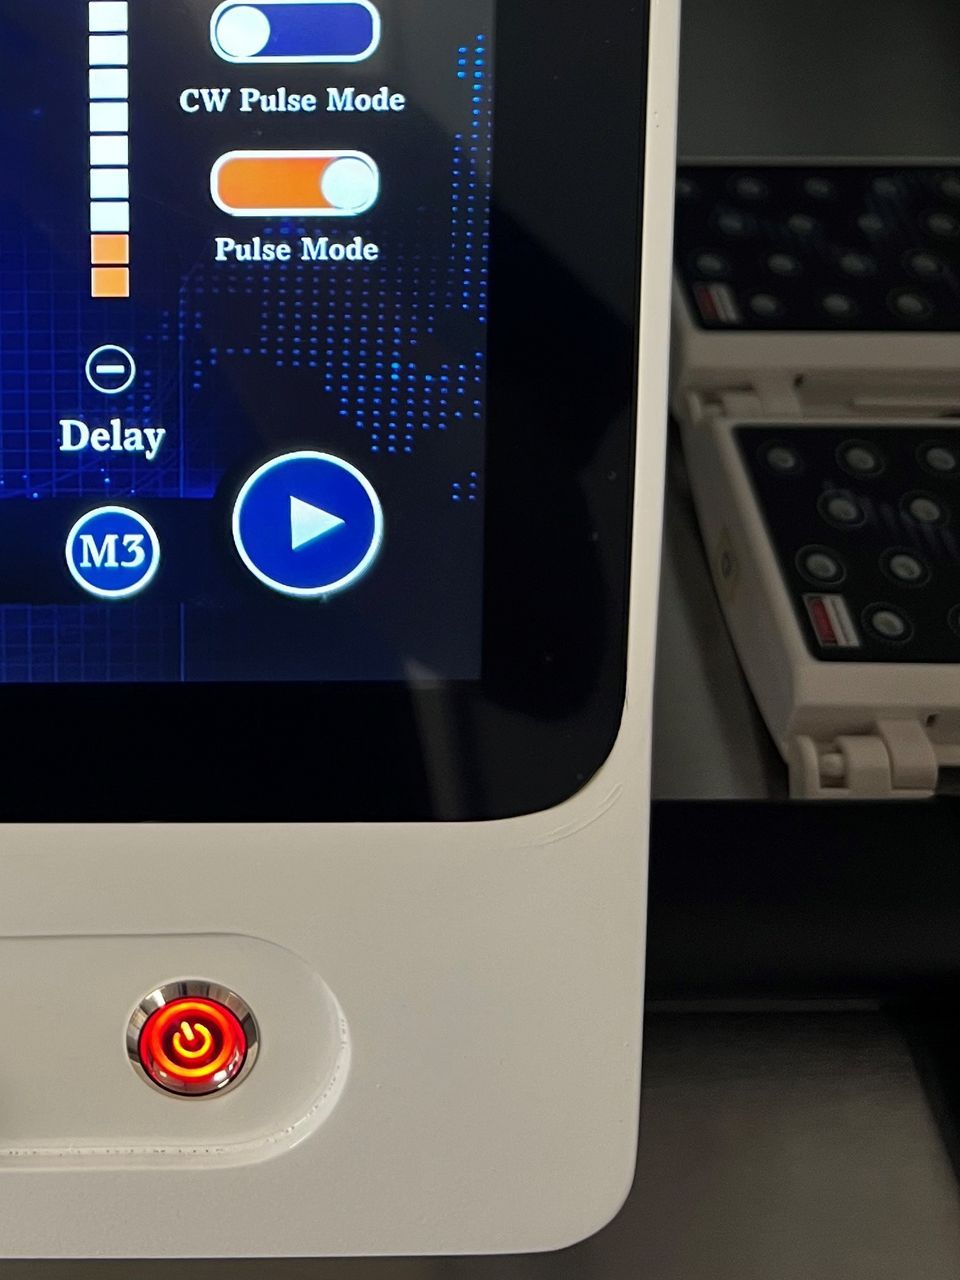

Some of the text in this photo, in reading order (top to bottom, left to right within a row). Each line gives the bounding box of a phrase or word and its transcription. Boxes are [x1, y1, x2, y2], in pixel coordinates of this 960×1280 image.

[179, 86, 406, 113] CW Pulse Mode
[214, 235, 379, 262] Pulse Mode
[58, 417, 167, 461] Delay
[78, 531, 146, 569] M3
